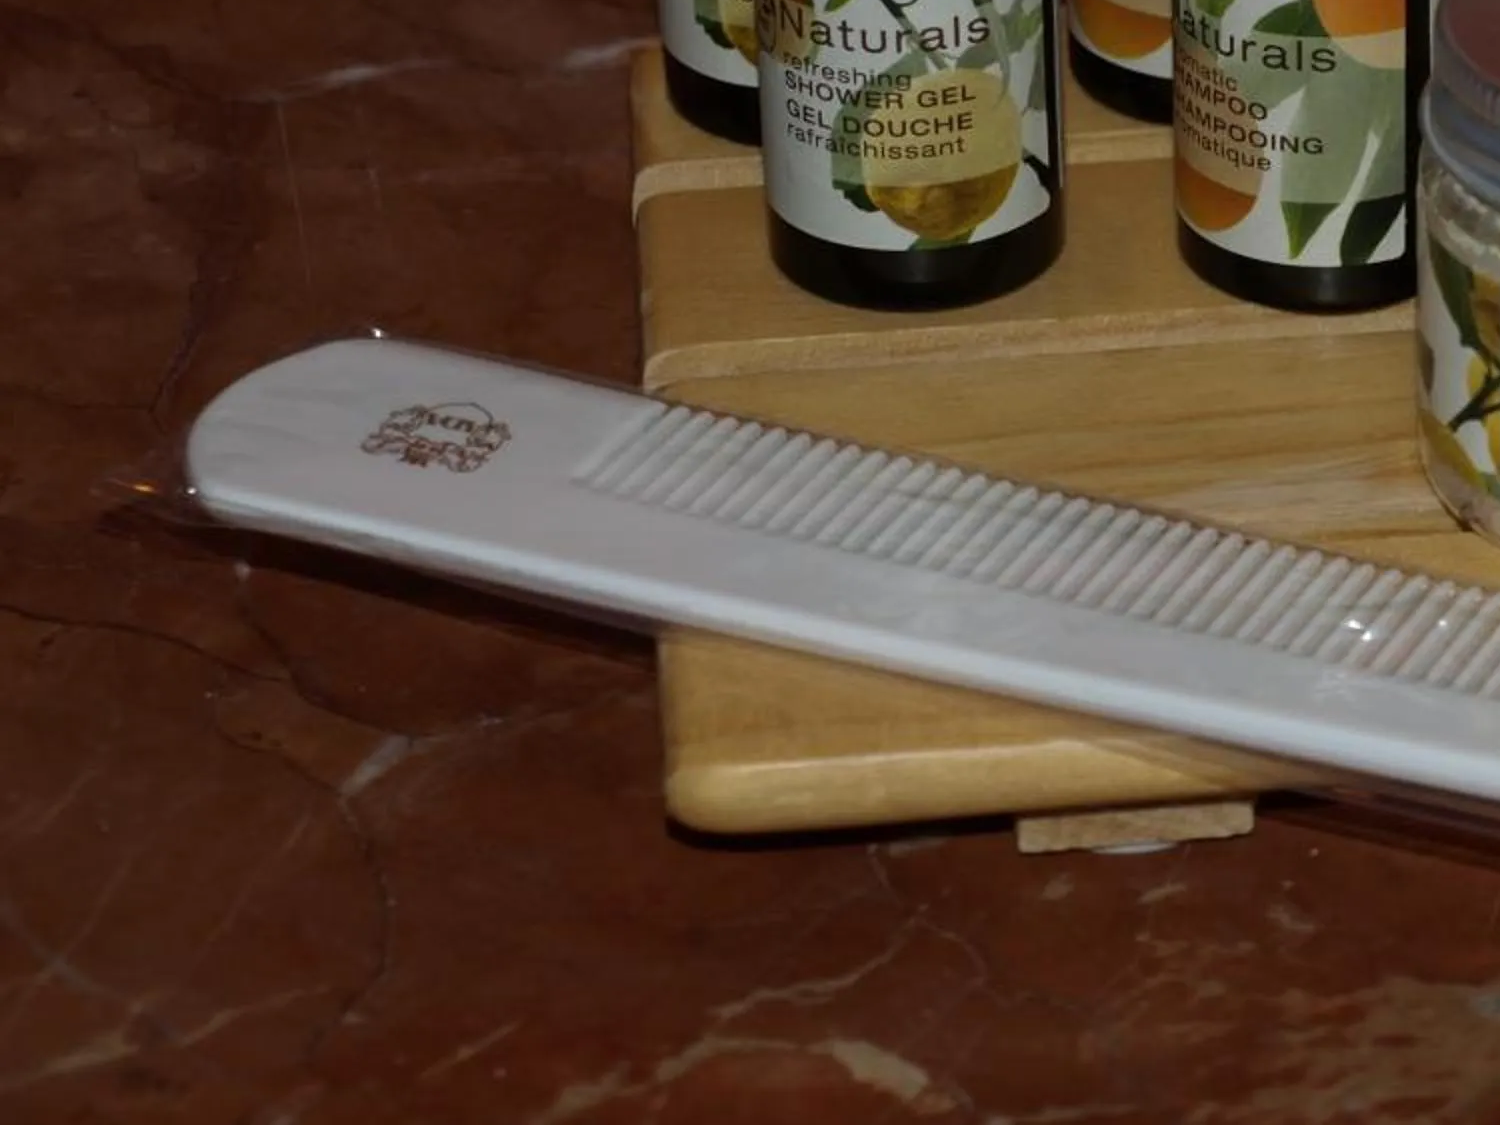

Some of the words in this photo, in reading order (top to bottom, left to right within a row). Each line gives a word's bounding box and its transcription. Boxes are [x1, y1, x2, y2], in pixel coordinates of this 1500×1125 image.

[1180, 6, 1338, 73] aturals
[783, 51, 913, 92] refreshing
[785, 69, 904, 110] SHOWER
[916, 85, 977, 109] GEL
[1178, 65, 1268, 121] HAMPOO
[786, 97, 833, 130] GEL
[842, 111, 975, 138] DOUCHE
[1177, 89, 1325, 155] HAMPOOING
